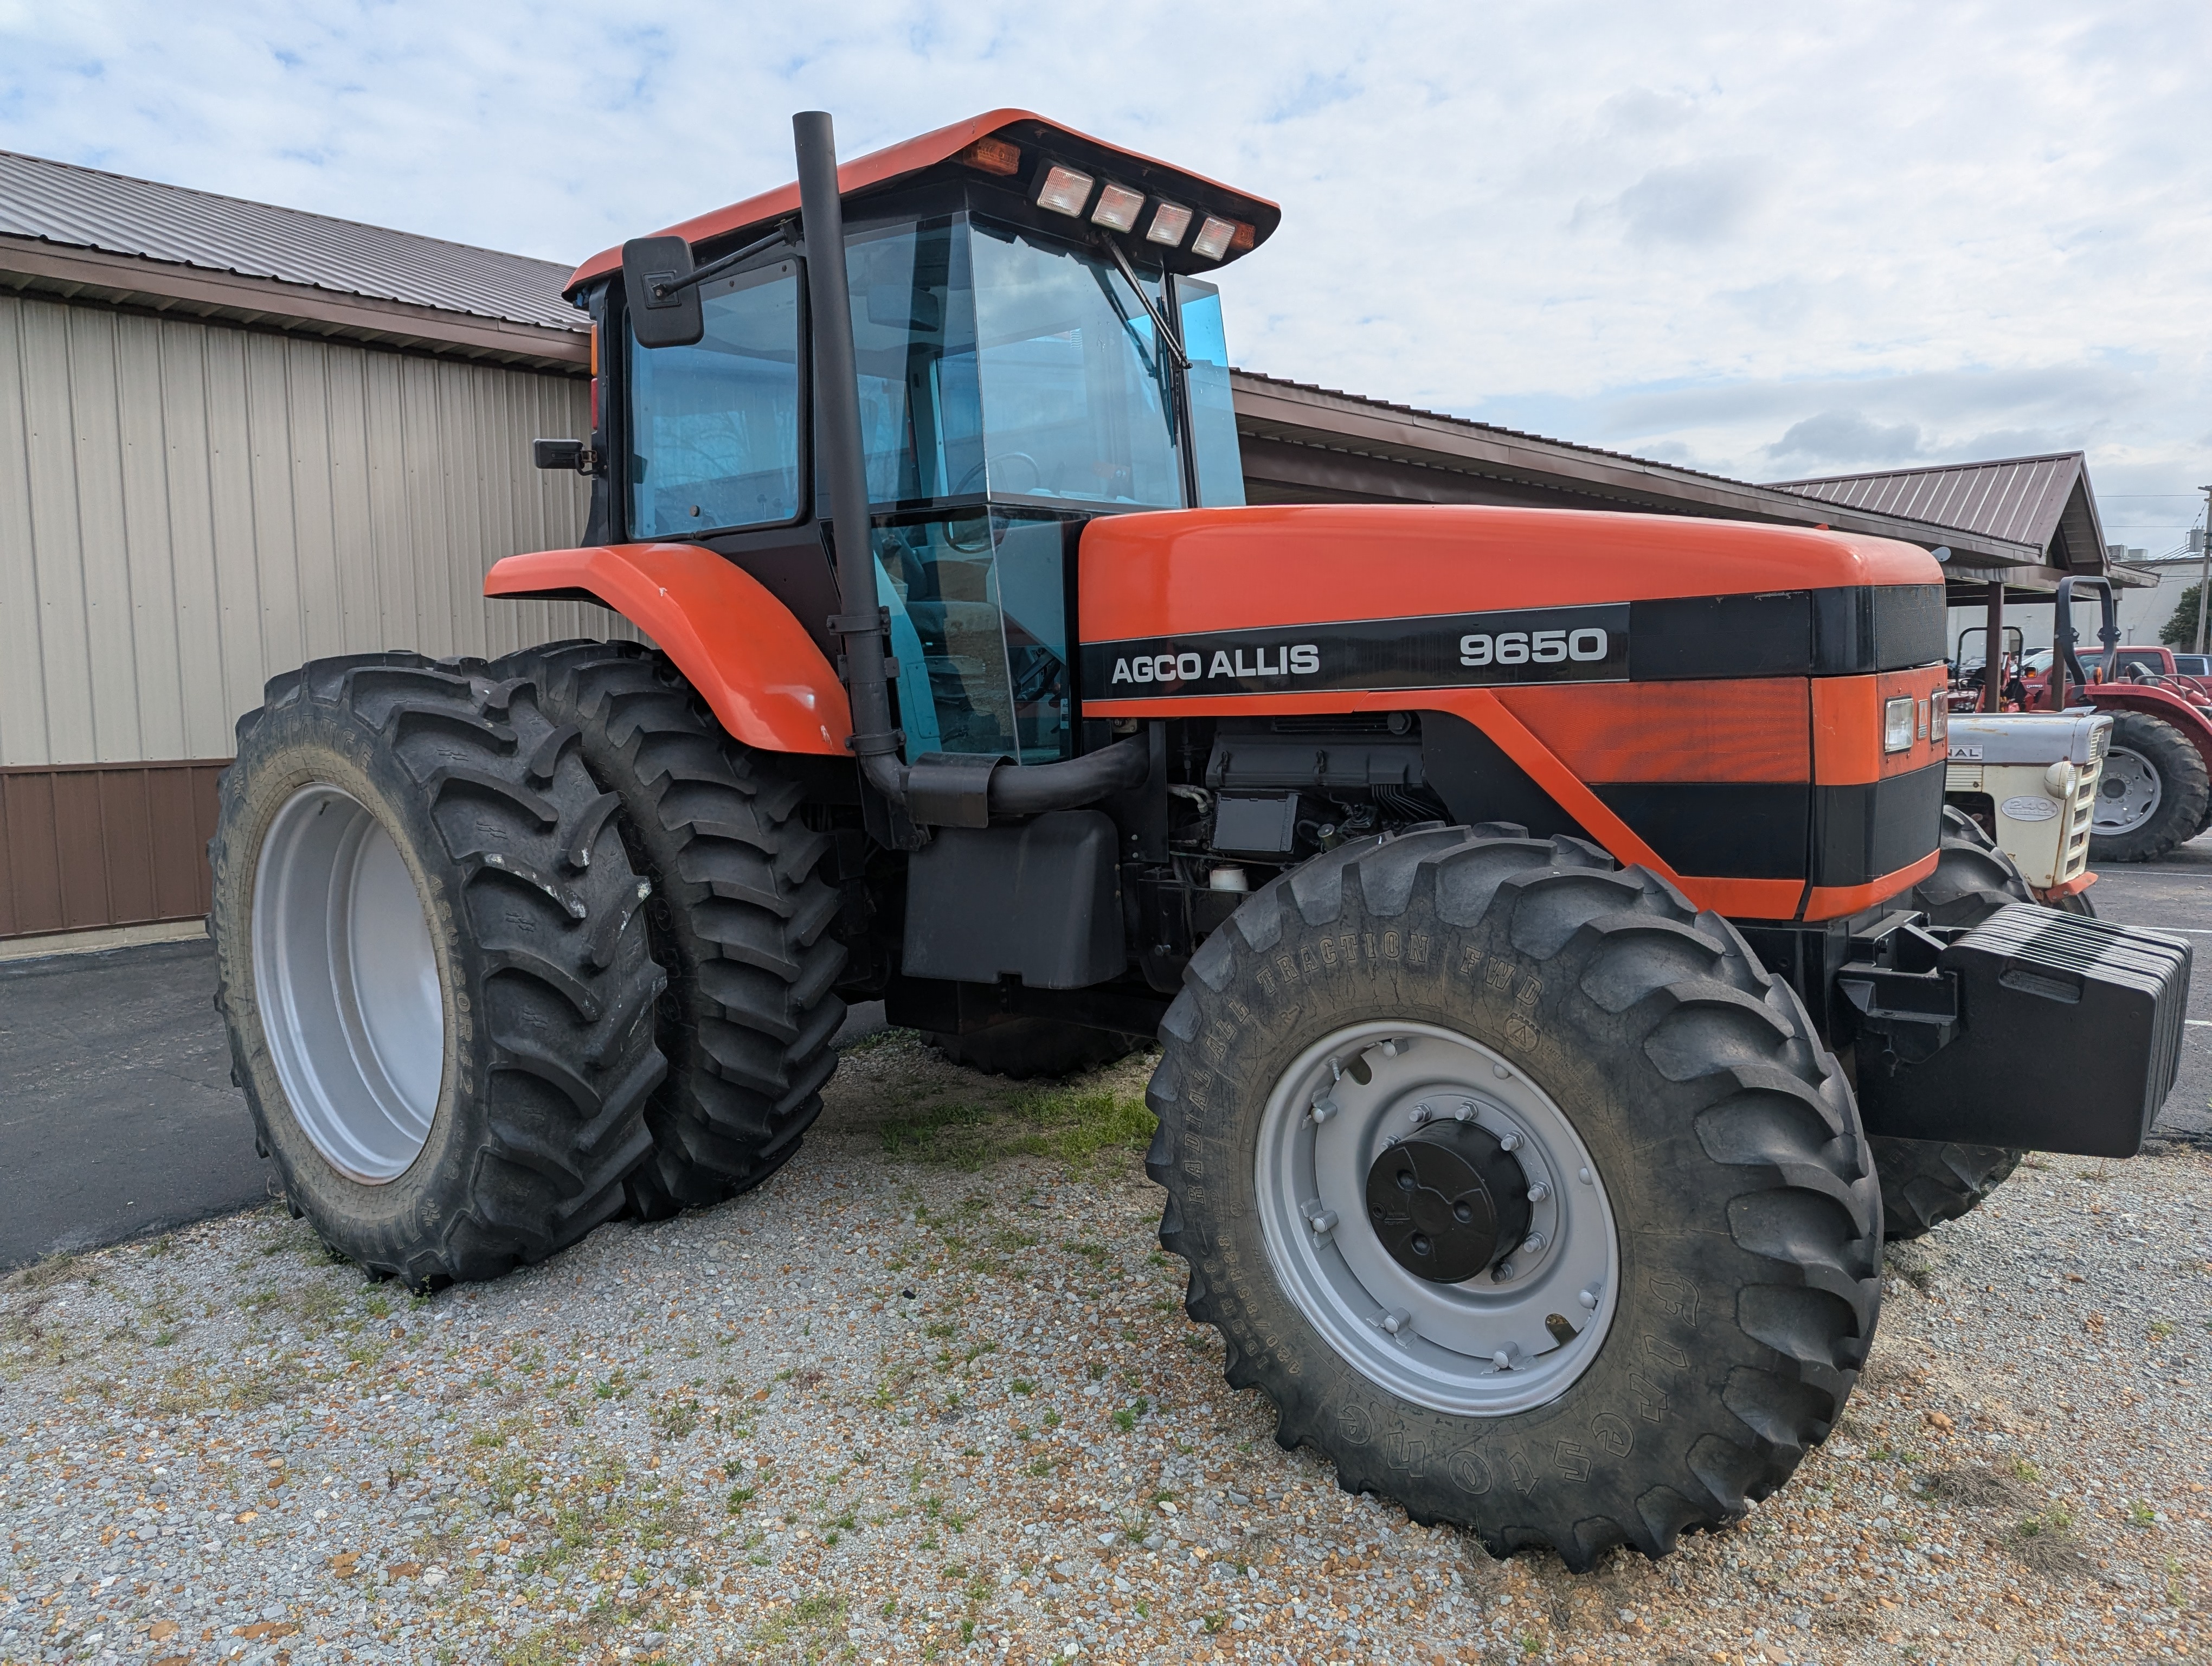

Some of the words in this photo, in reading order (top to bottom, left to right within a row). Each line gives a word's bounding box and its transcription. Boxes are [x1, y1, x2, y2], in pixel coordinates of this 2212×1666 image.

[1111, 652, 1201, 684] AGCO
[1208, 644, 1320, 678] ALLIS
[1459, 627, 1608, 666] 9650
[2009, 799, 2050, 811] 240
[1184, 1070, 1213, 1205] RADIAL
[1205, 999, 1249, 1060] ALL
[1256, 930, 1429, 995] TRACTION
[1459, 945, 1543, 1005] FWD
[1203, 1260, 1269, 1370] 16.9R28
[1217, 1235, 1300, 1375] 420/85R28
[1339, 1277, 1700, 1497] Firestone
